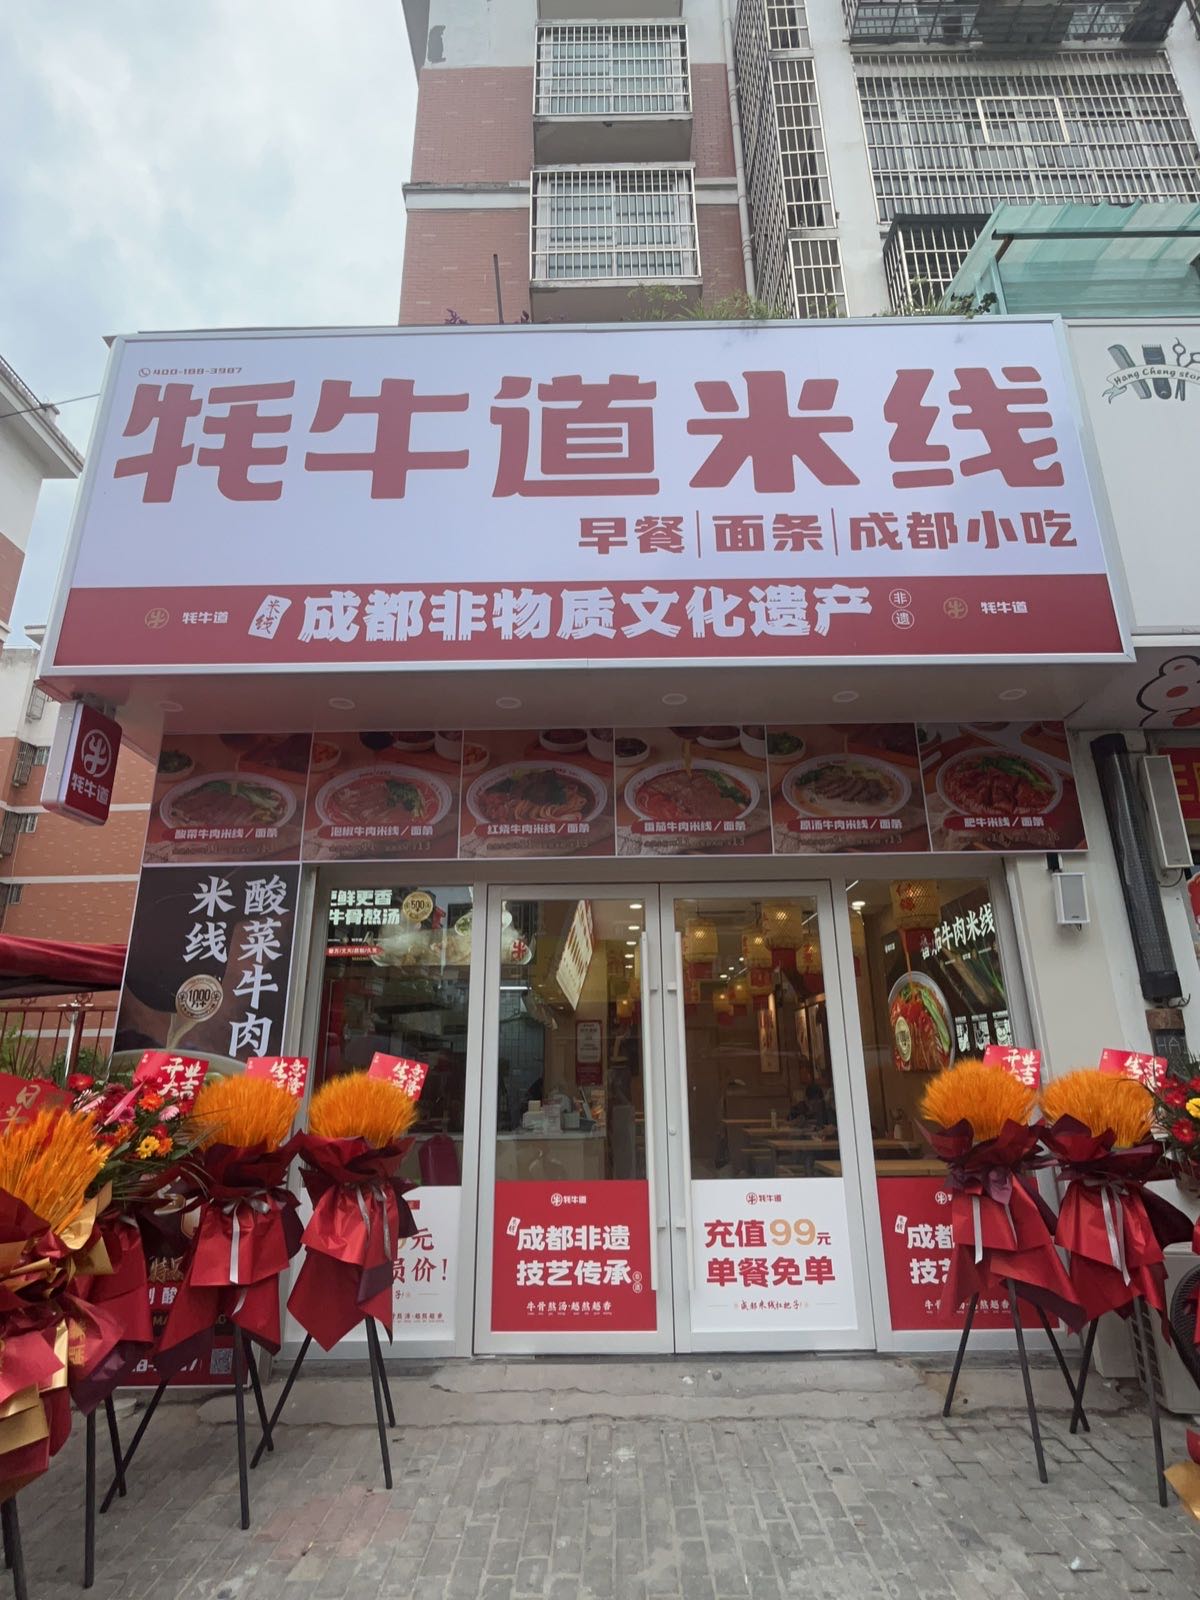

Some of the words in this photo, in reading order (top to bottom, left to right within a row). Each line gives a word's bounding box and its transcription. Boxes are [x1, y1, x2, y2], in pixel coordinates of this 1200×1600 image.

[114, 366, 1064, 503] 牦牛道米线
[578, 515, 684, 555] 早餐
[712, 513, 824, 552] 面条
[849, 510, 1078, 551] 成都小吃
[182, 611, 229, 625] 牦牛道
[297, 583, 873, 643] 成都非物质文化遗产
[980, 601, 1029, 615] 牦牛道
[71, 773, 110, 806] 牦牛道
[183, 875, 236, 963] 米线
[229, 874, 290, 1058] 酸菜牛肉
[517, 1225, 631, 1251] 成都非遗
[704, 1218, 832, 1248] 充值99元
[516, 1259, 632, 1286] 技艺传承
[706, 1256, 836, 1288] 单餐免单
